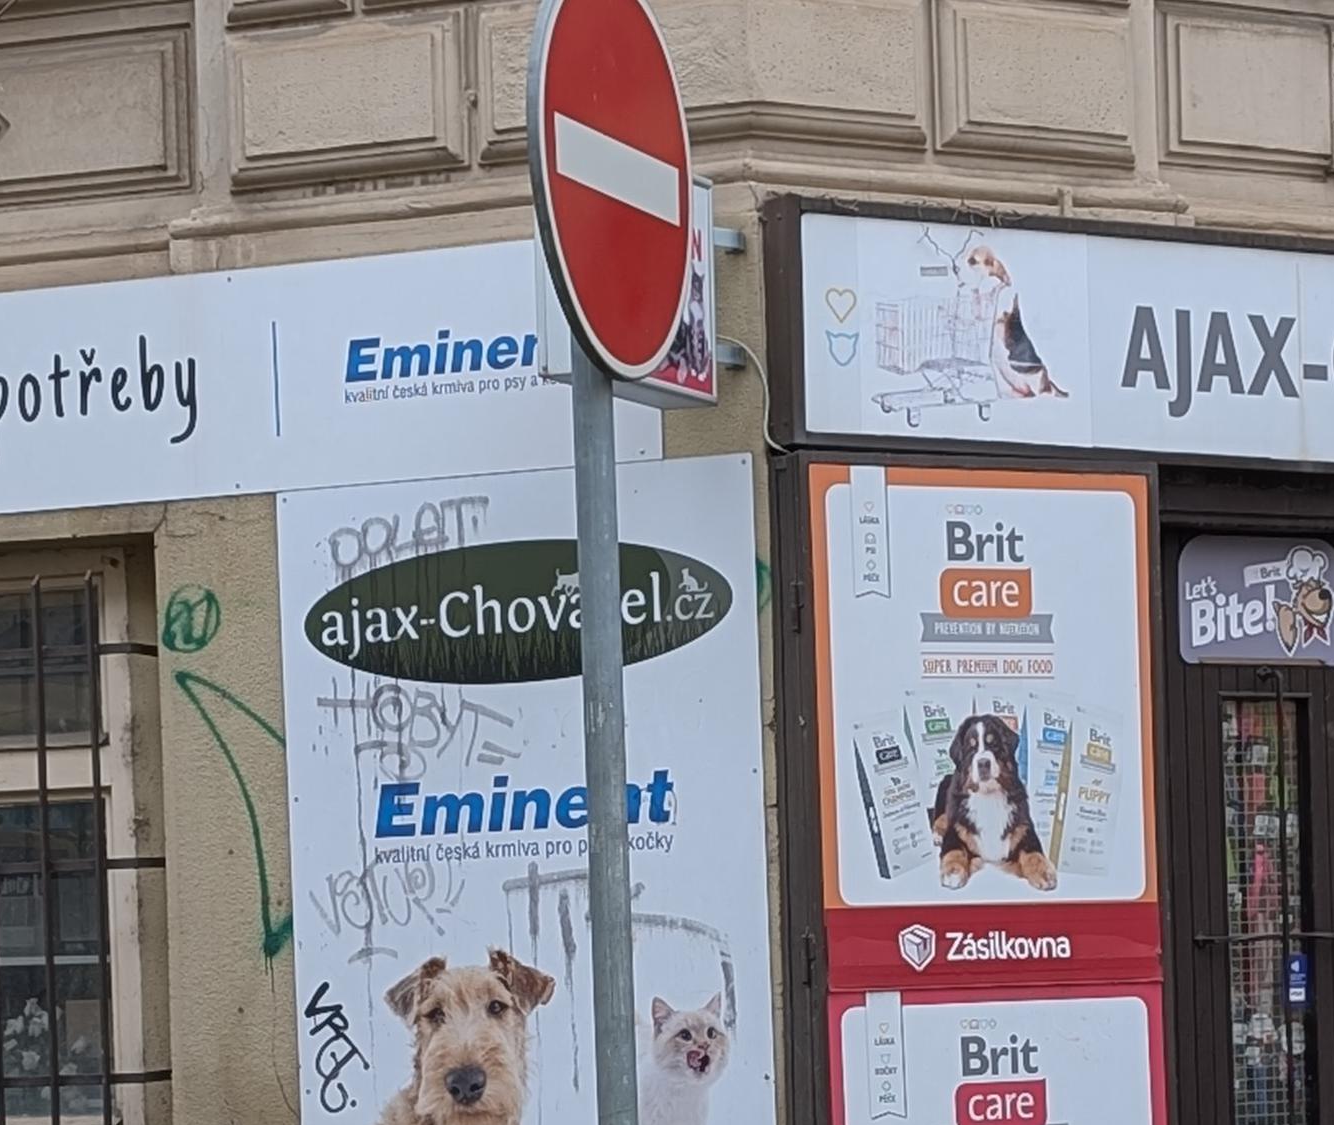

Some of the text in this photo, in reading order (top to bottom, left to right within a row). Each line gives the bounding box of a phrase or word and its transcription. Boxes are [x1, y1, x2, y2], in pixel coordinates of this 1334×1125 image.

[345, 329, 539, 383] Eminen
[344, 385, 389, 403] kvalitní
[392, 382, 428, 400] česká
[432, 378, 475, 397] krmiva
[479, 377, 500, 394] pro
[504, 374, 526, 391] psy
[530, 375, 538, 386] a
[946, 520, 1024, 563] Brit
[1185, 576, 1218, 600] Let's
[1259, 566, 1282, 580] Brit
[952, 579, 1020, 608] care
[320, 571, 716, 662] ajax-Chovael.cz
[934, 622, 983, 635] PREVENTION
[985, 622, 996, 635] BY
[1191, 584, 1276, 647] Bite!
[922, 659, 1054, 674] SUPER PREMIUM DOG FOOD
[374, 844, 431, 864] kvalitní
[435, 841, 481, 862] česká
[485, 838, 540, 858] krmiva
[545, 839, 573, 858] pro
[945, 930, 1072, 961] Zásilkovna
[960, 1033, 1040, 1077] Brit
[967, 1091, 1036, 1122] care
